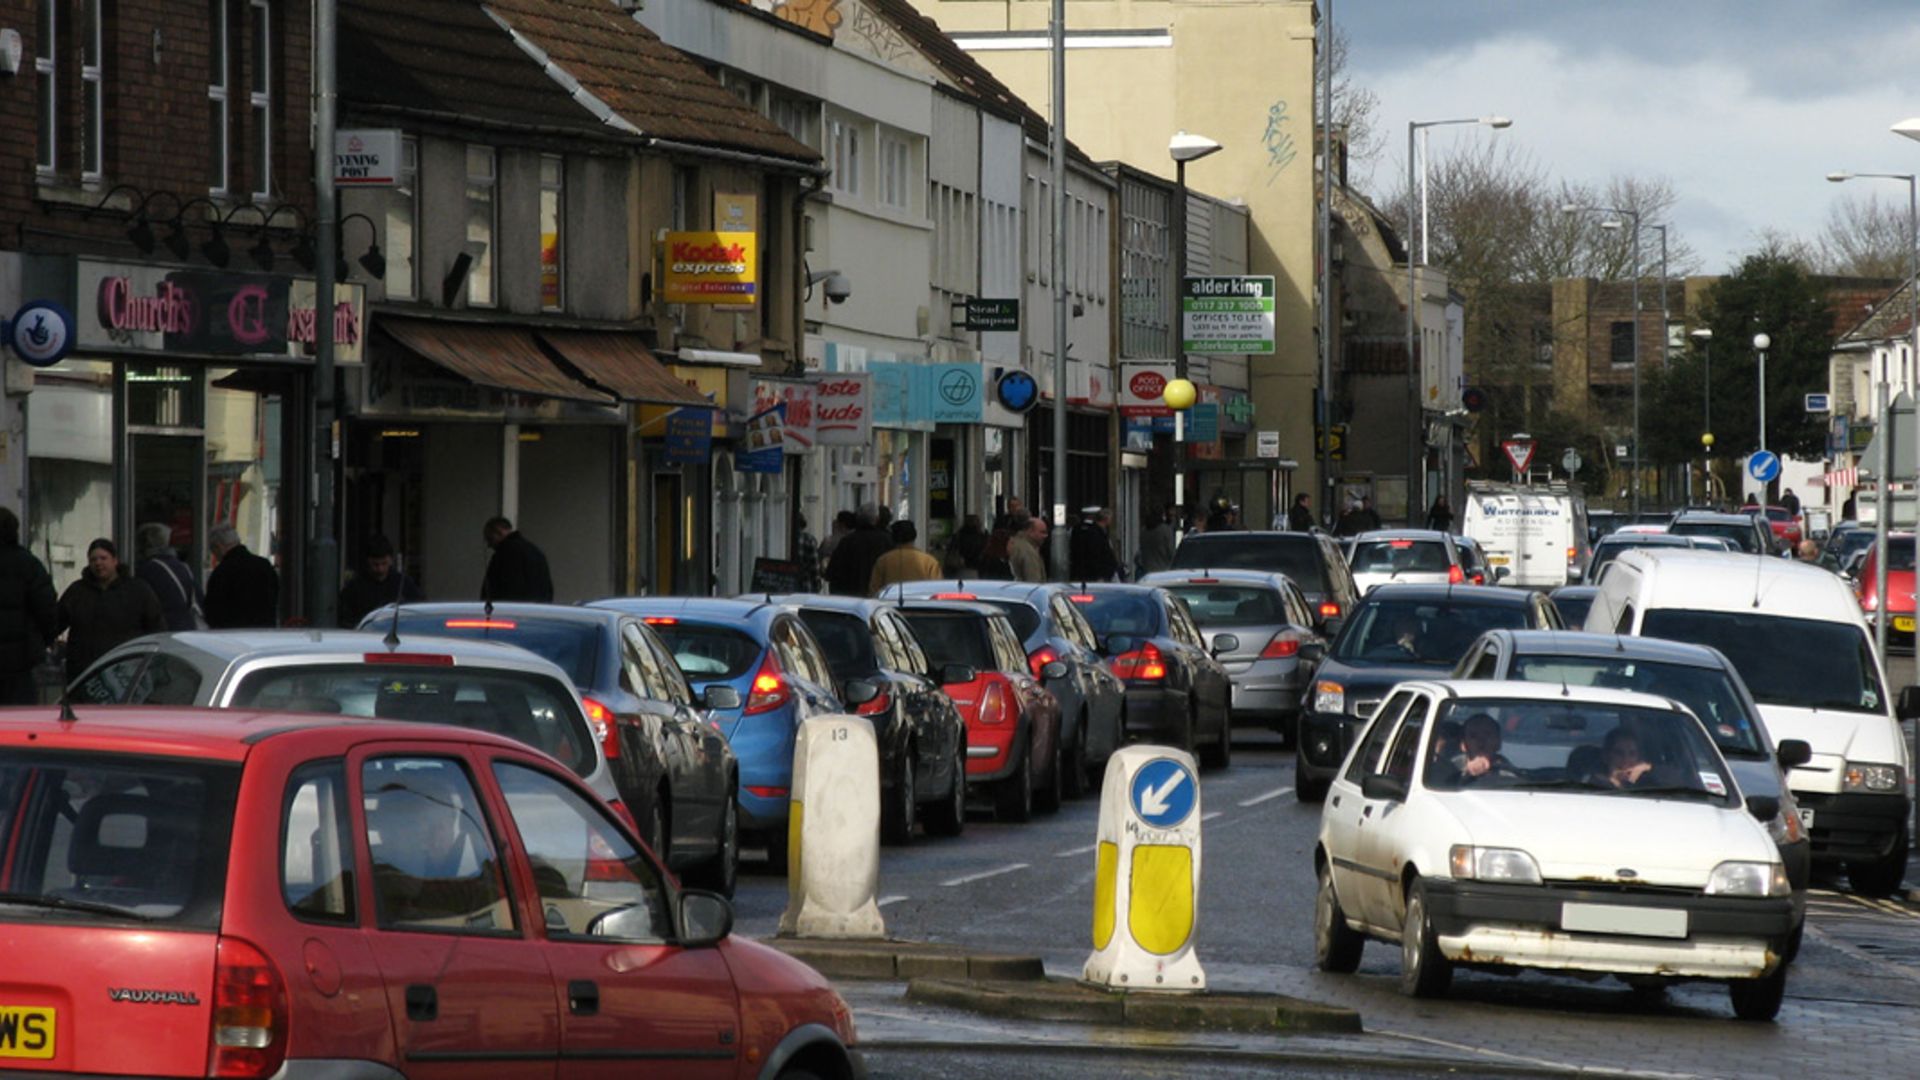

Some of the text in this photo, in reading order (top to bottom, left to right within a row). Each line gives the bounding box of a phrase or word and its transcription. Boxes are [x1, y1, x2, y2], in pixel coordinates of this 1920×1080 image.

[336, 154, 379, 165] VENING
[341, 167, 368, 177] POST
[672, 241, 746, 262] Kodak
[672, 262, 746, 275] express
[671, 283, 746, 293] Digital Solutions
[102, 276, 192, 333] Church's
[968, 303, 999, 315] Stead
[968, 315, 1016, 327] Simpson
[1192, 314, 1263, 322] OFFICES TO LET
[1192, 341, 1263, 352] alderking.com
[1137, 375, 1160, 385] POST
[816, 379, 861, 396] aste
[935, 409, 980, 420] pharmacy
[832, 728, 847, 741] 13
[108, 988, 200, 1005] VAUXHALL
